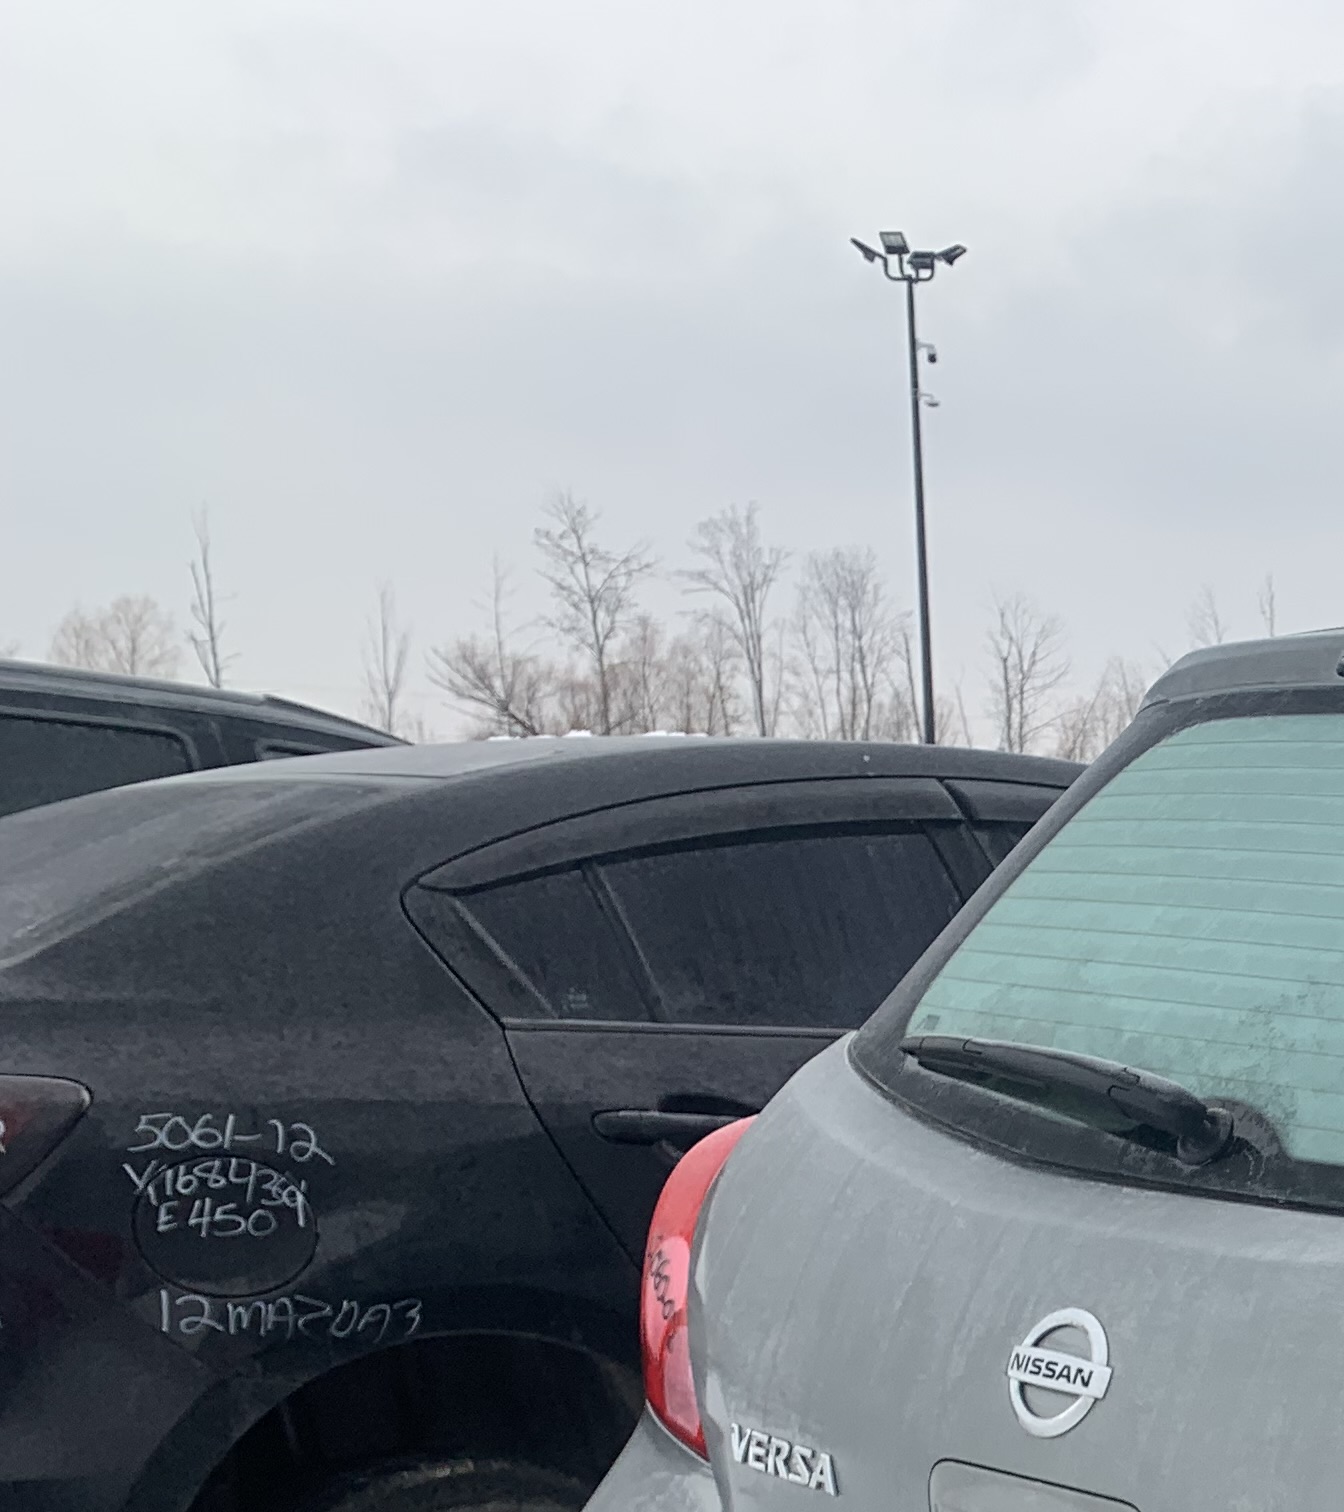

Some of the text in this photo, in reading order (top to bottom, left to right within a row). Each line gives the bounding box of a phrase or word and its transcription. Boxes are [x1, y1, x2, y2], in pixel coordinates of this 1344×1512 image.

[126, 1112, 336, 1166] 5061-12
[1010, 1352, 1095, 1388] NISSAN
[730, 1422, 840, 1499] VERSA
